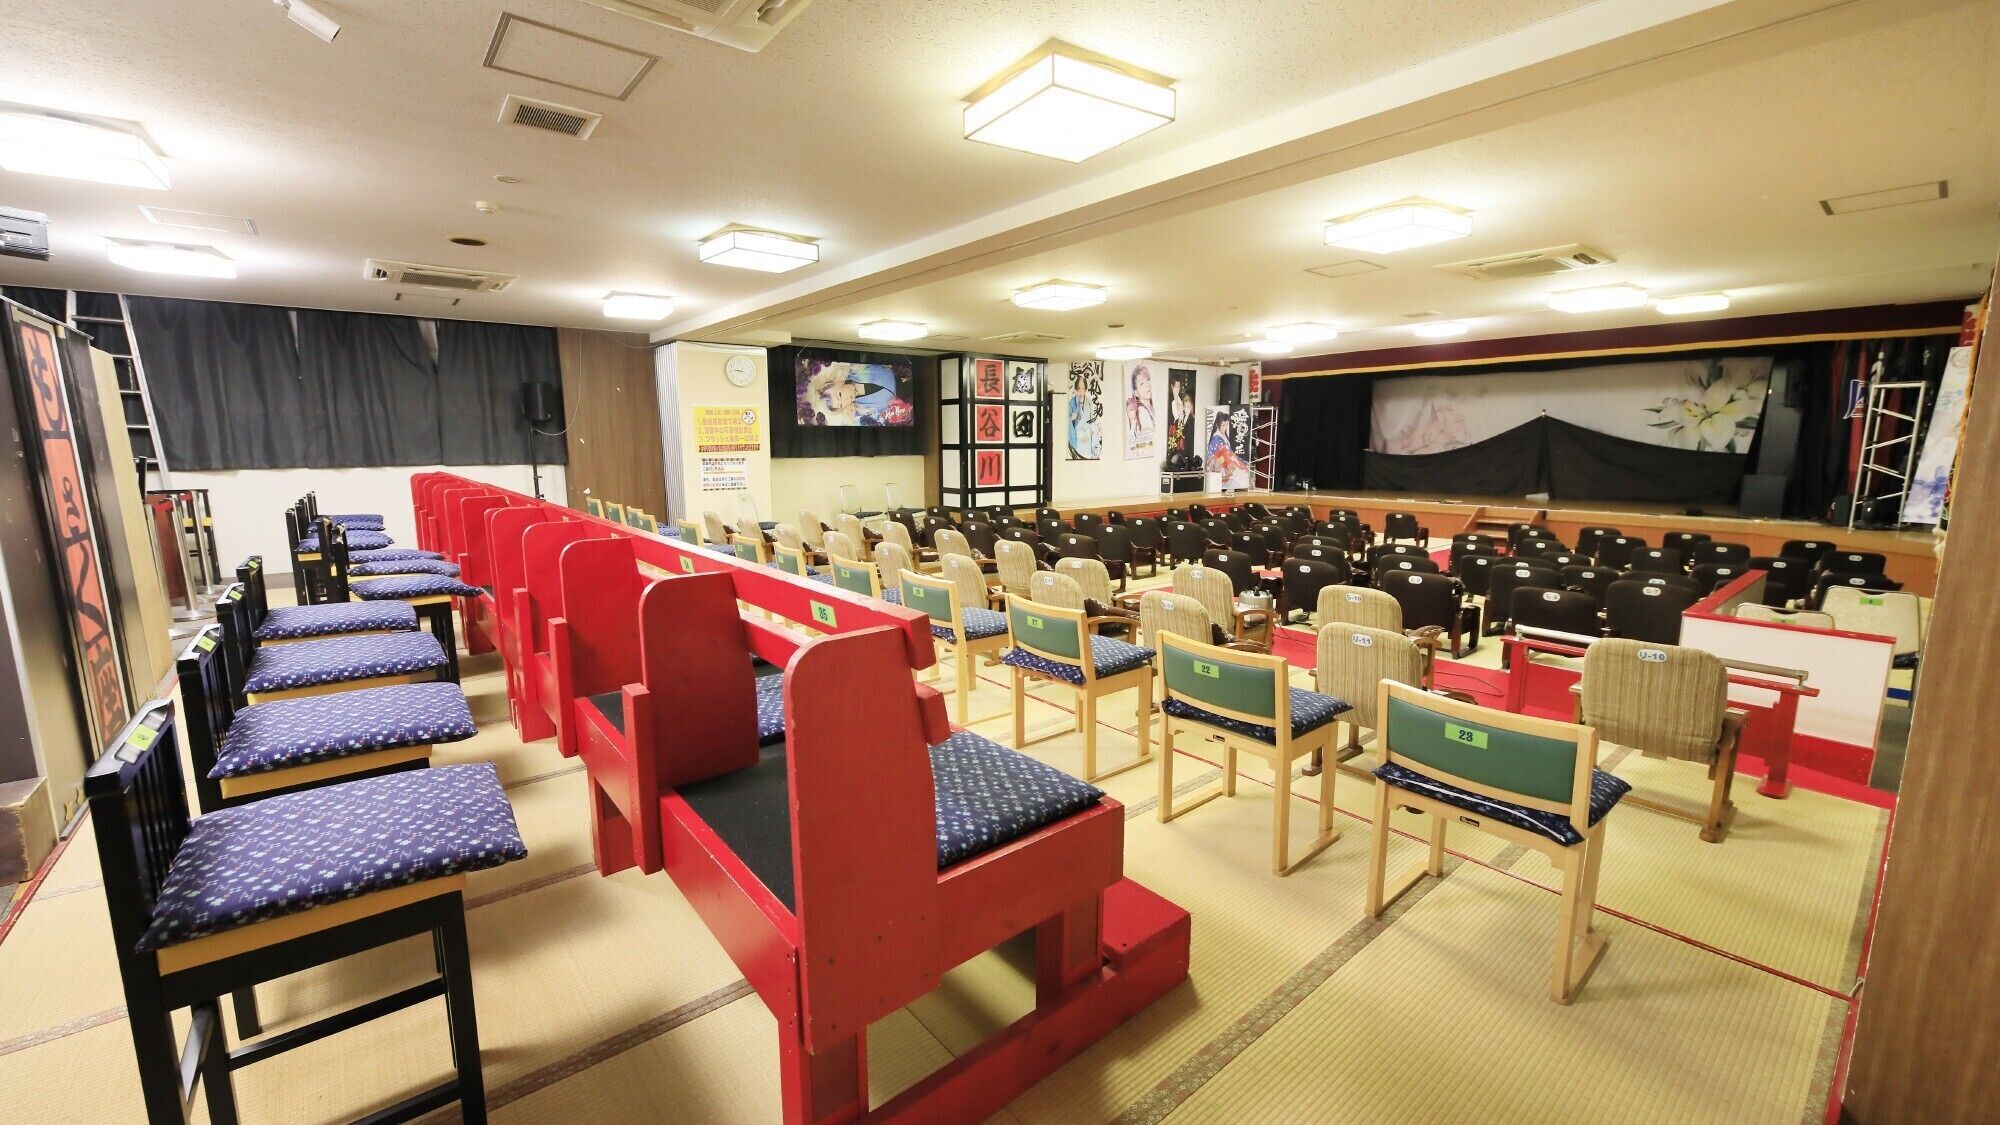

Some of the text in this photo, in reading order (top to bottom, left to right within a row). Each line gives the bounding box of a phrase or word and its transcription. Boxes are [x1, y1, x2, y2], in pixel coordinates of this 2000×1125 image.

[979, 364, 1001, 482] 長谷川
[1201, 664, 1211, 674] 22
[1458, 729, 1474, 743] 23
